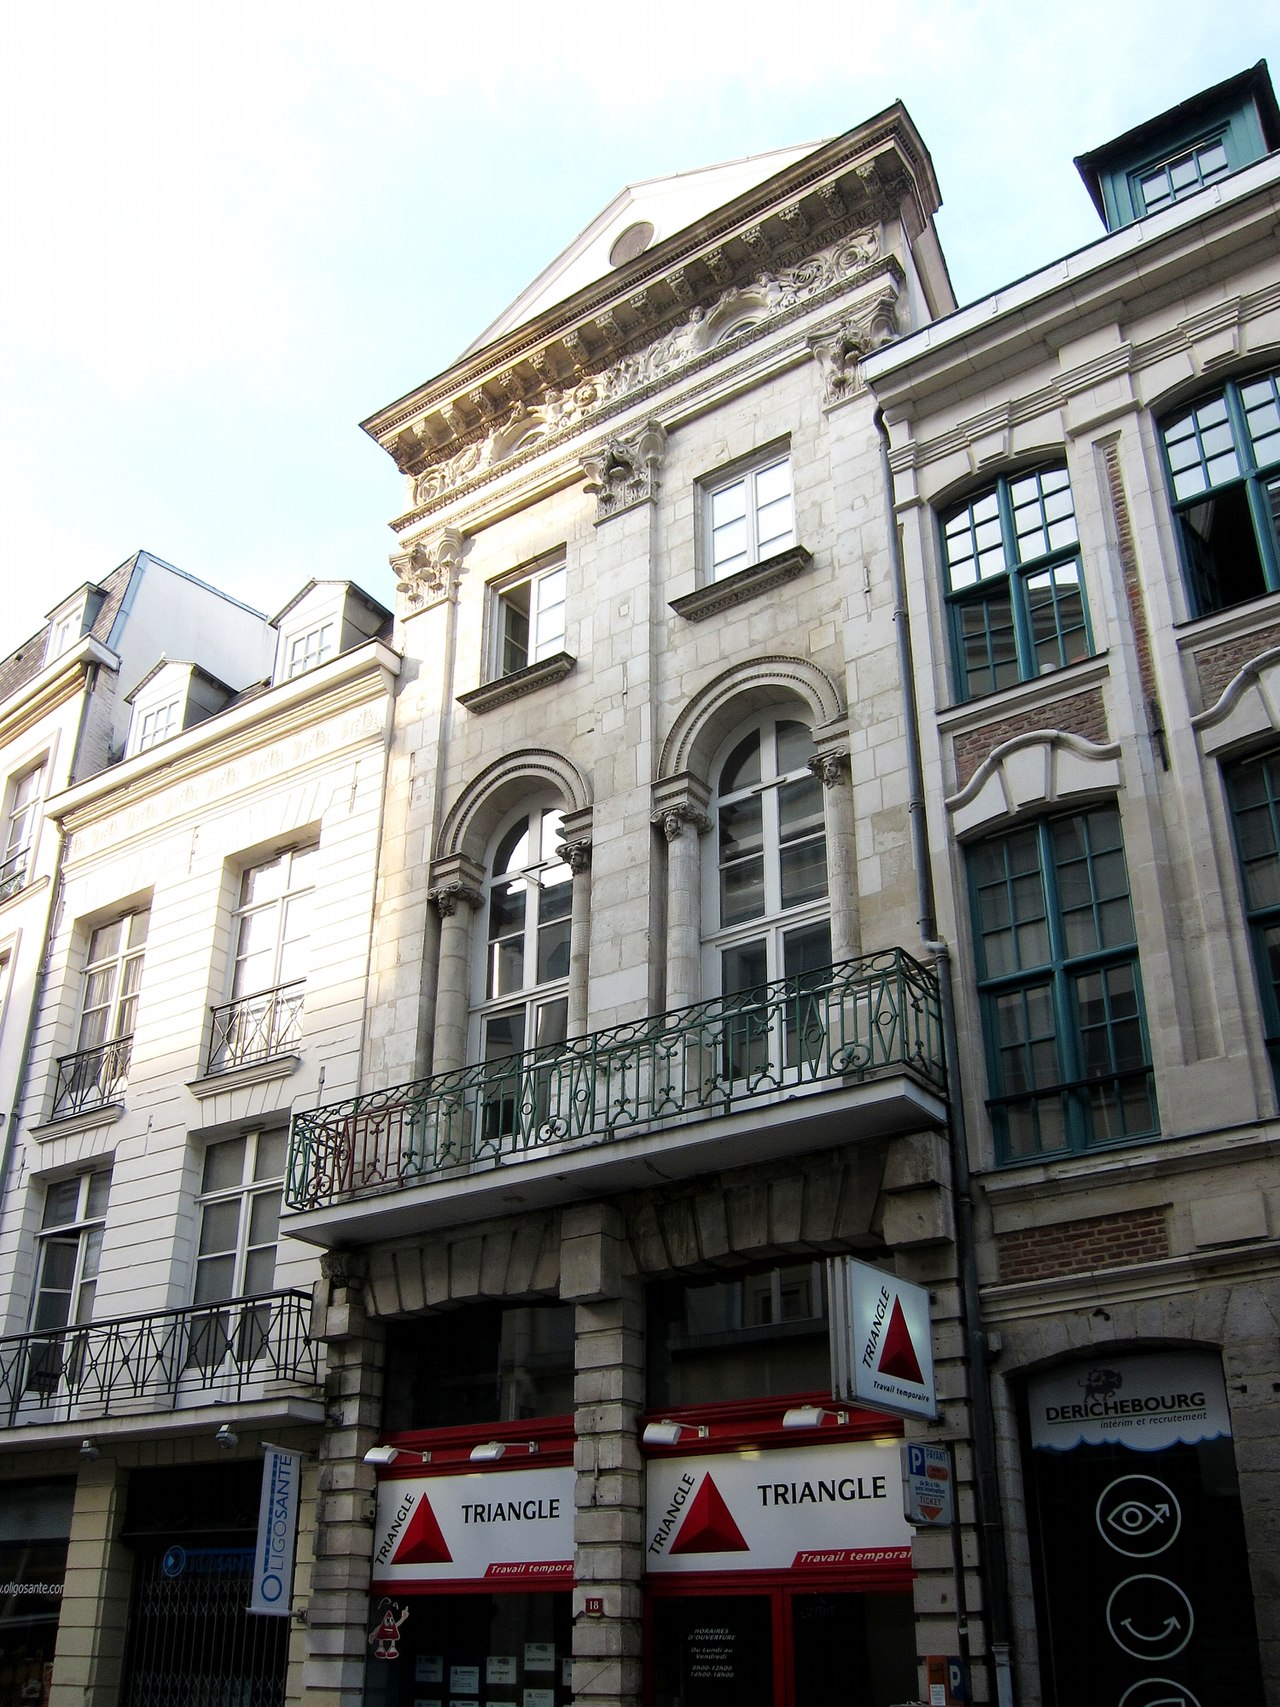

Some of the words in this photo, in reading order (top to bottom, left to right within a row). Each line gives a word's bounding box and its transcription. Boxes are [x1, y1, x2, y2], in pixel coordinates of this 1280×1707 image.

[862, 1286, 890, 1369] TRIANGLE
[873, 1380, 895, 1393] Travail
[896, 1388, 930, 1403] temporaire
[1045, 1392, 1206, 1422] DERICHEBOURG
[1136, 1416, 1146, 1426] et
[1149, 1411, 1208, 1425] recrutement
[911, 1448, 922, 1474] P
[926, 1448, 946, 1462] PAYANT
[757, 1475, 887, 1506] TRIANGLE
[920, 1496, 942, 1506] TICKET
[461, 1498, 560, 1524] TRIANGLE
[648, 1472, 696, 1556] TRIANGLE
[260, 1454, 292, 1602] OLIGOSANTE
[374, 1492, 416, 1566] TRIANGLE
[491, 1564, 526, 1574] Travail
[528, 1563, 575, 1574] tempora
[800, 1551, 846, 1563] Travail
[850, 1548, 912, 1562] temporai
[589, 1601, 599, 1610] 18
[949, 1665, 961, 1692] P
